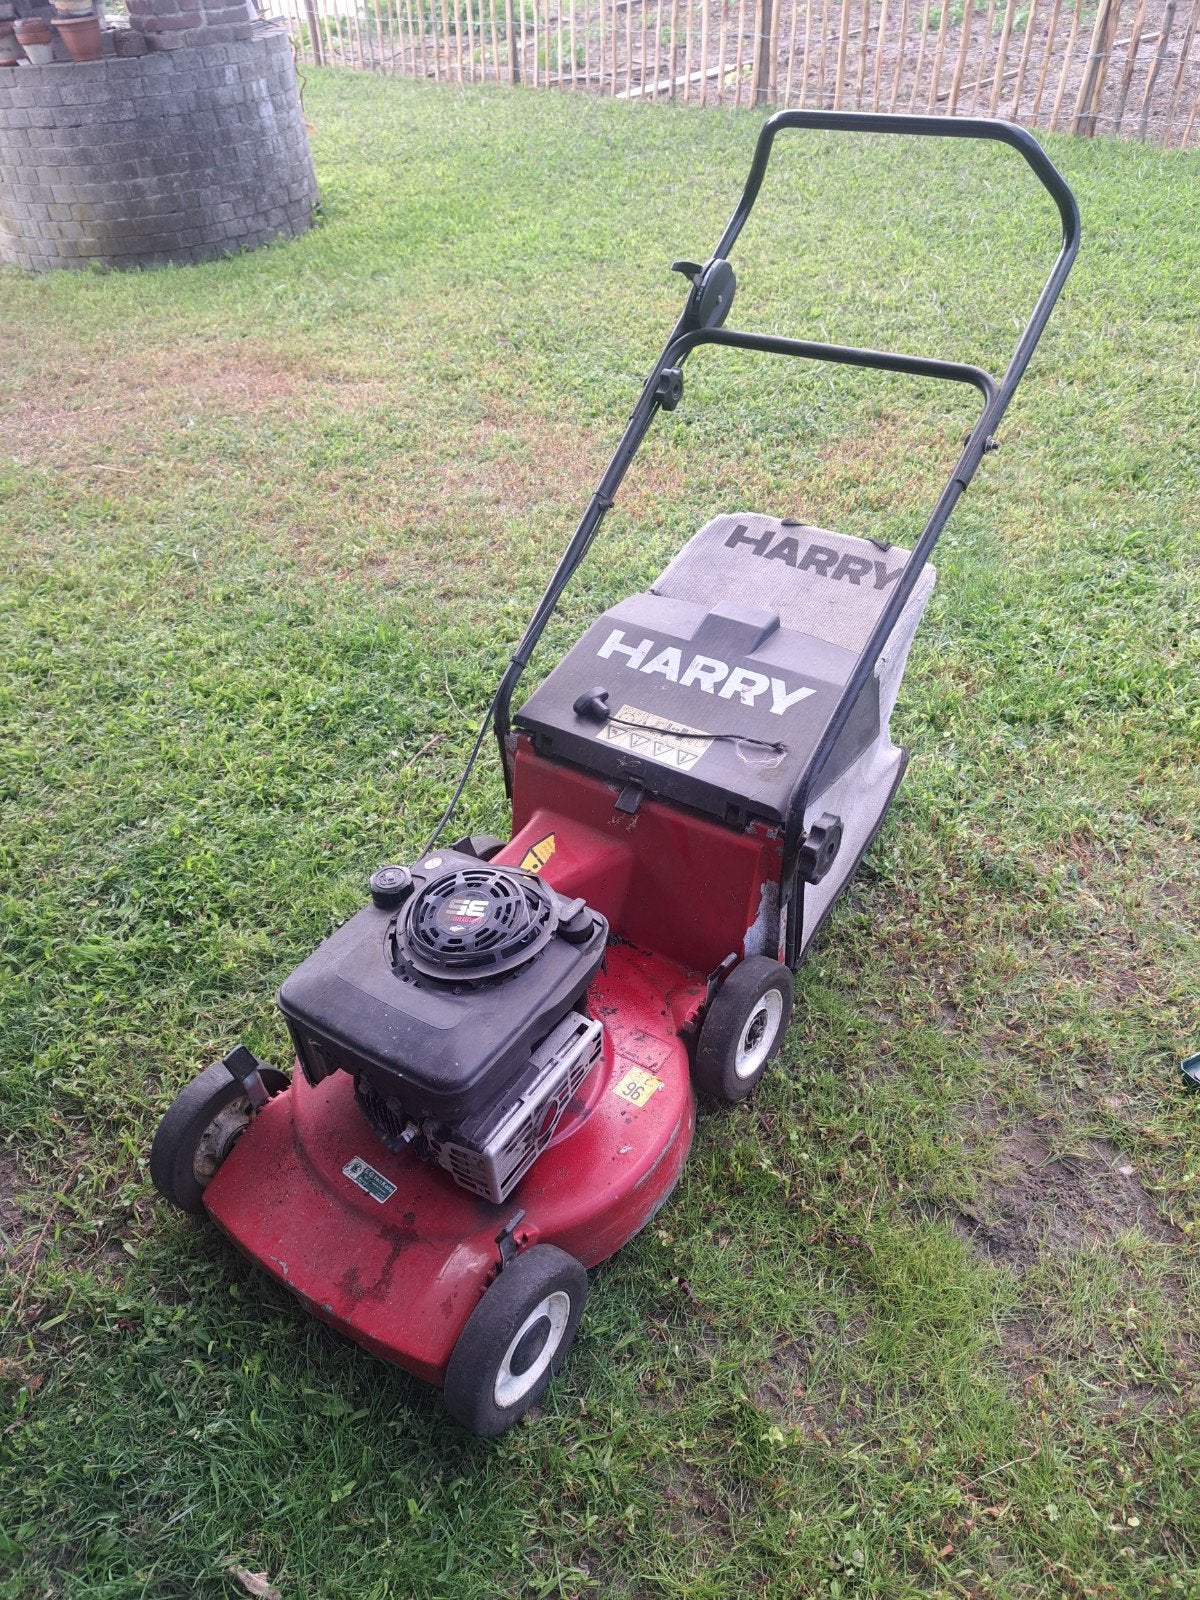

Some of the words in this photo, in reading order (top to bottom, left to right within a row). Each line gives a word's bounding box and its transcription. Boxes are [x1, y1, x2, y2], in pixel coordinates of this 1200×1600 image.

[724, 524, 906, 591] HARRY
[596, 628, 818, 716] HARRY
[622, 1081, 645, 1100] 96
